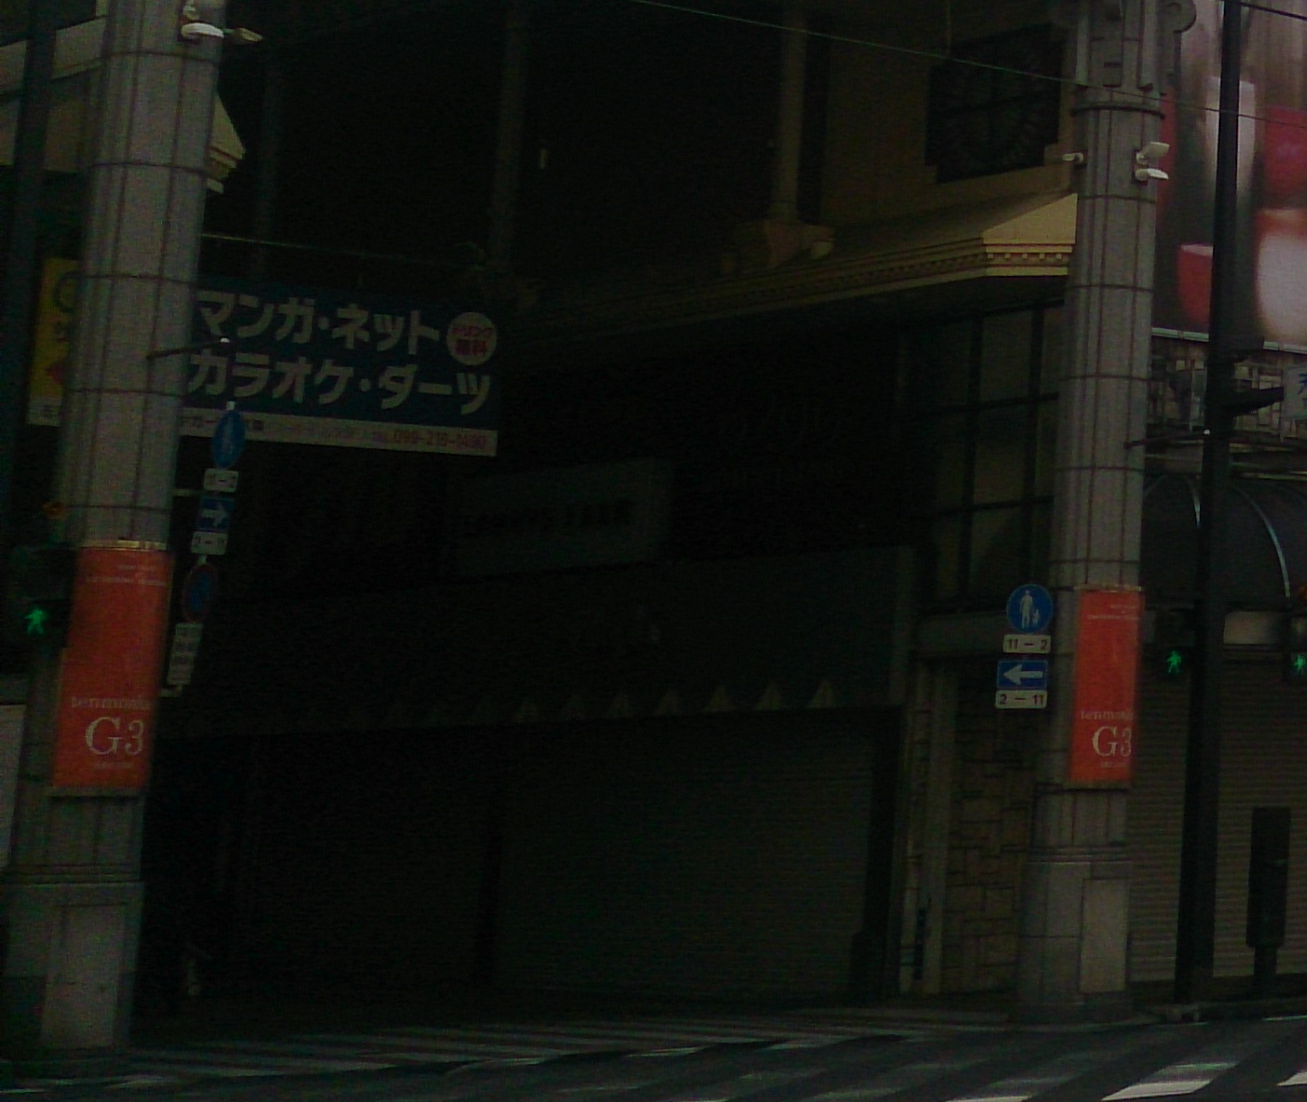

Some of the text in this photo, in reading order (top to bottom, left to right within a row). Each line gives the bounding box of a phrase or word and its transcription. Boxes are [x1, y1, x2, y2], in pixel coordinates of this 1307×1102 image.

[198, 290, 440, 356] マンガ・ネット
[187, 348, 491, 416] カラオケ・ダーツ
[84, 716, 145, 756] G3
[1091, 725, 1133, 758] G3
